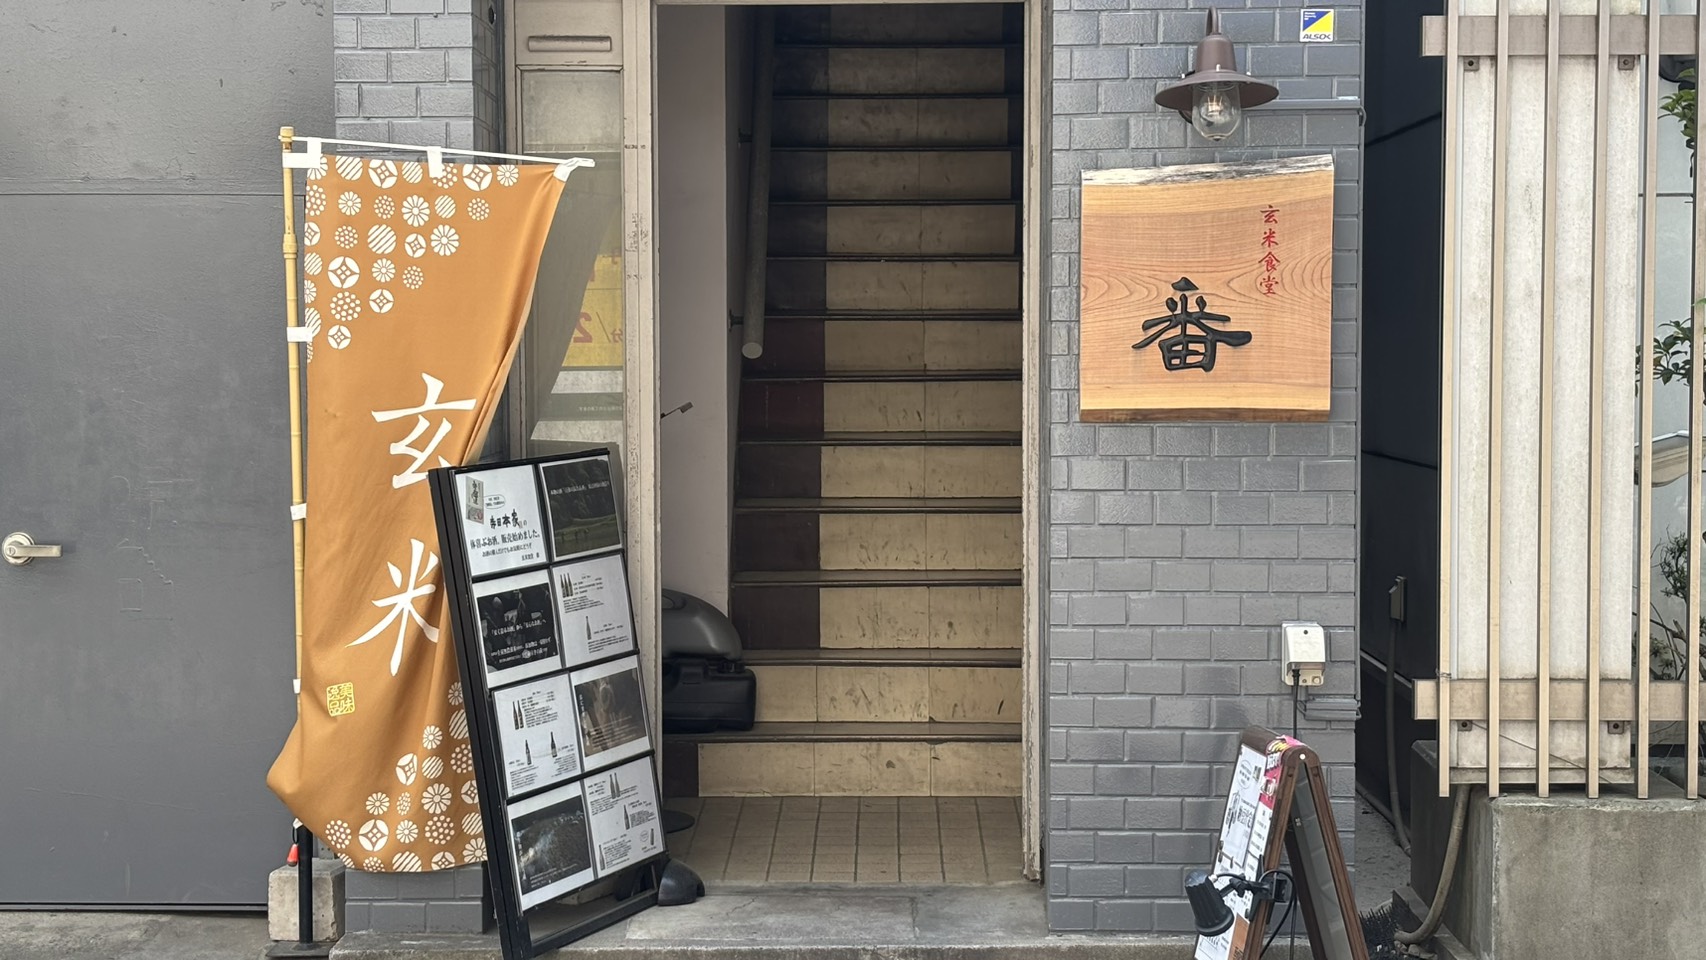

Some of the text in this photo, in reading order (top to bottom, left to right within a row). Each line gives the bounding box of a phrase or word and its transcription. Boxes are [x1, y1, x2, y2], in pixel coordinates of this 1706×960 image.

[1257, 204, 1281, 296] 玄米食堂
[1131, 276, 1253, 373] 番
[345, 372, 477, 677] 玄米
